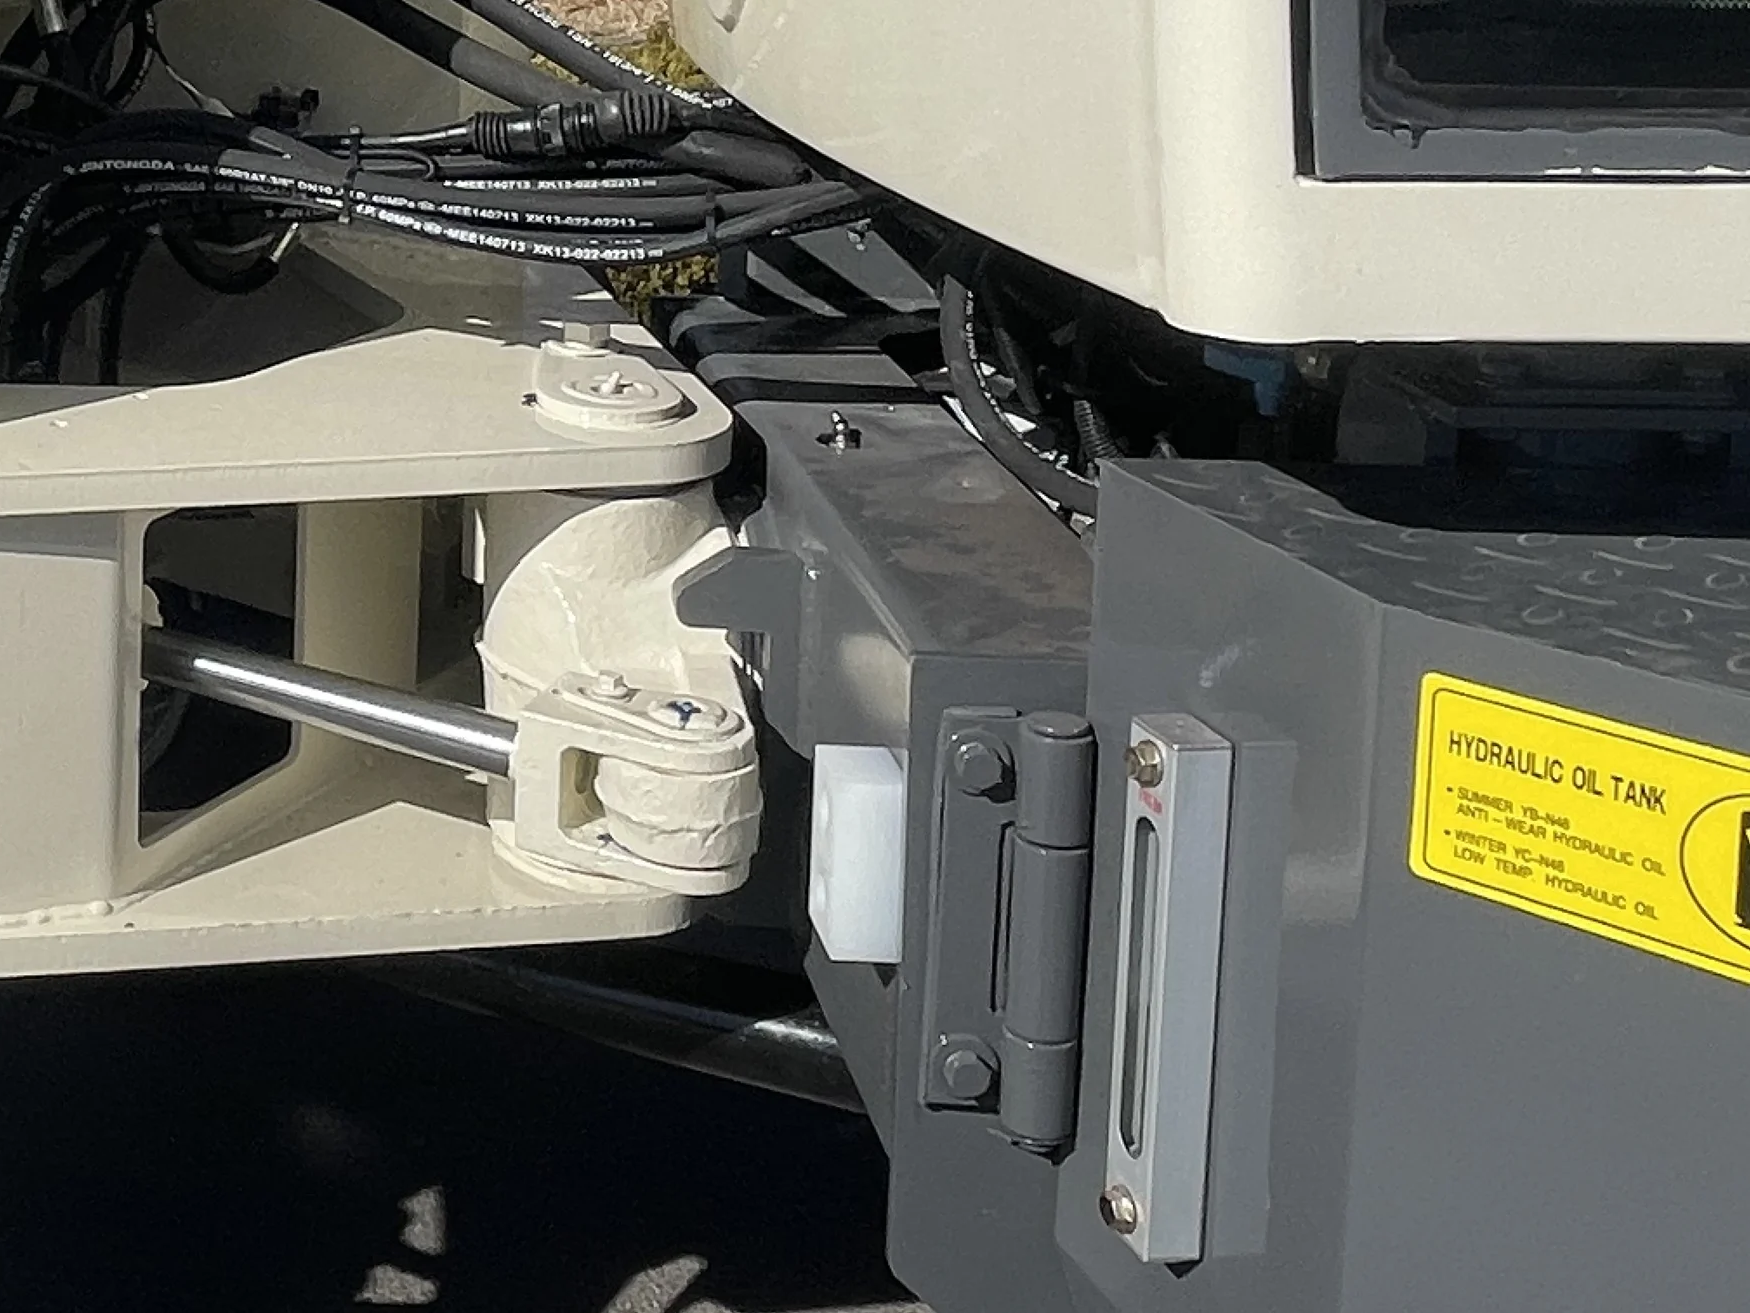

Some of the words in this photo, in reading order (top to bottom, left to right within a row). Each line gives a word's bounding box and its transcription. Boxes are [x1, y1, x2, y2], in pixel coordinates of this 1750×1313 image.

[1448, 729, 1564, 784] HYDRAULIC
[1572, 765, 1604, 797] OIL
[1610, 774, 1667, 815] TANK
[1457, 786, 1514, 814] SUMMER
[1455, 829, 1507, 855] WINTER
[1456, 803, 1489, 823] ANTI
[1505, 816, 1547, 839] WEAR
[1553, 831, 1634, 867] HYDRAULIC
[1641, 857, 1667, 877] OIL
[1454, 845, 1487, 866] LOW
[1545, 873, 1627, 910] HYDRAULIC
[1634, 901, 1659, 921] OIL
